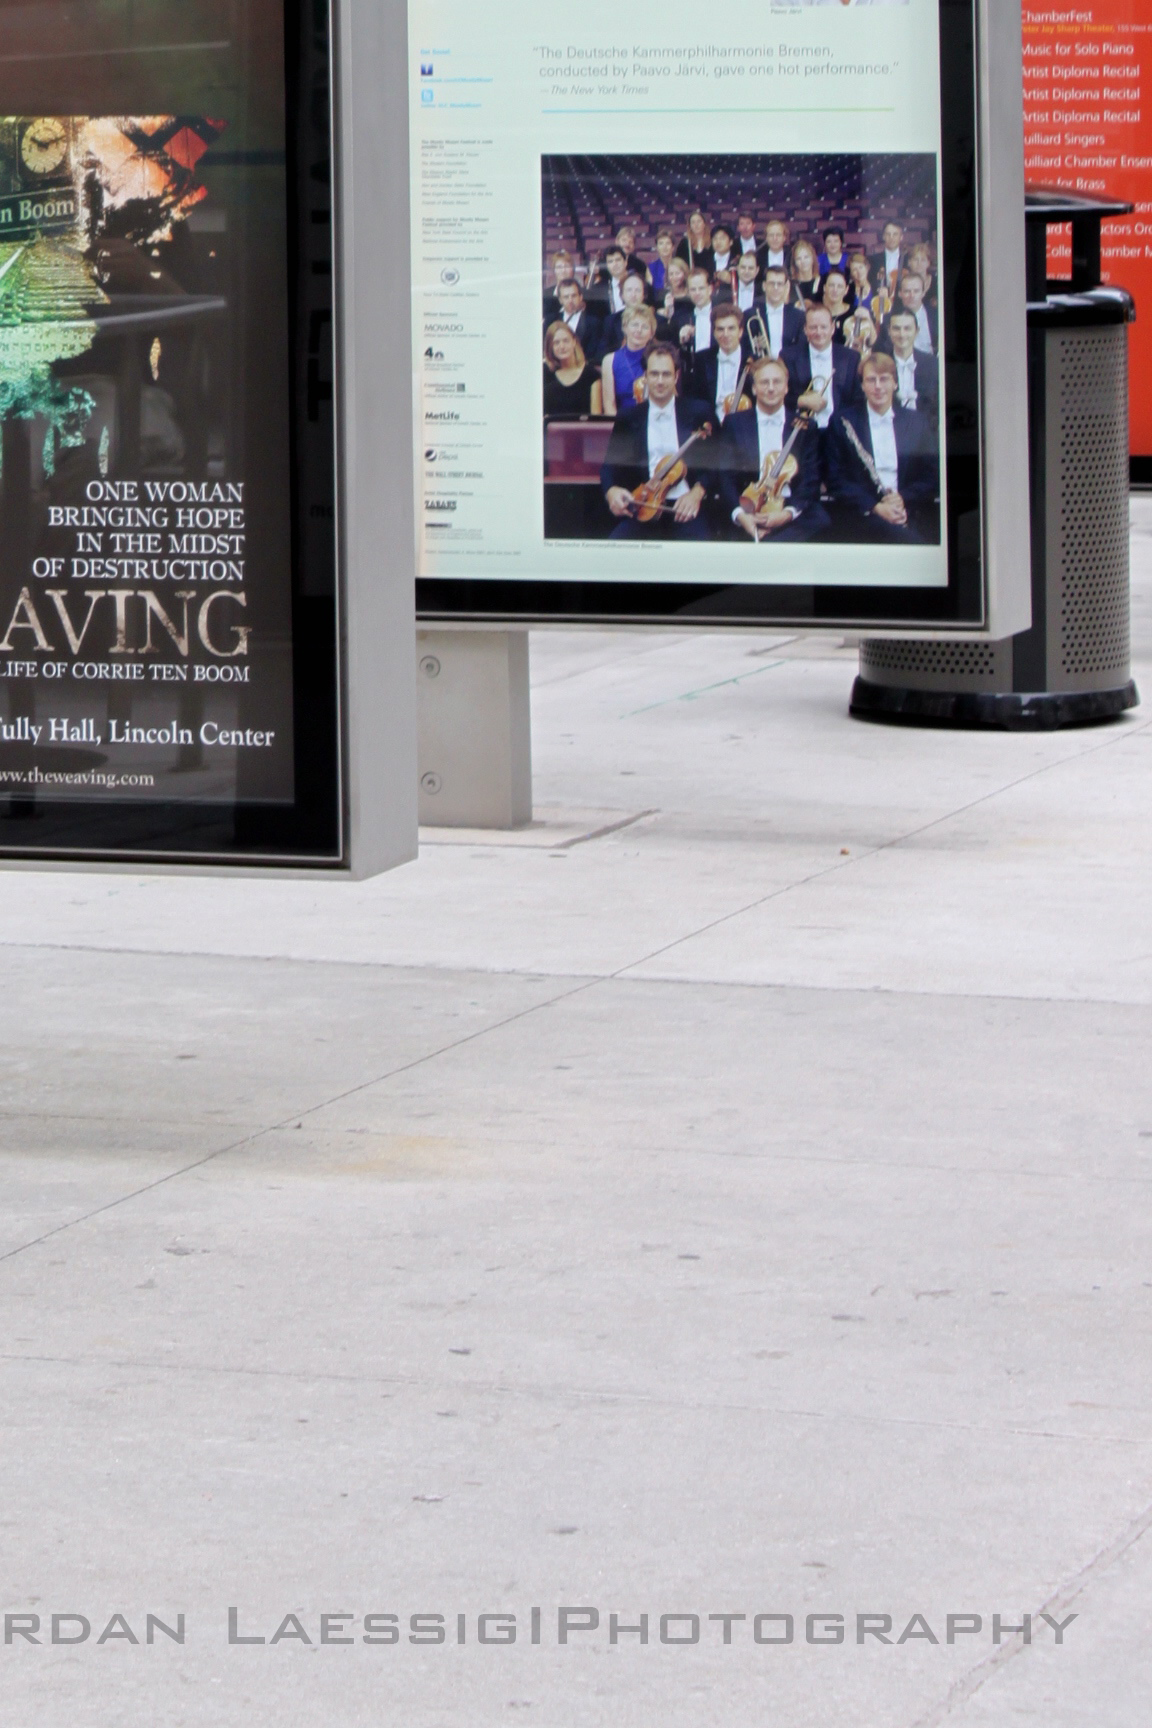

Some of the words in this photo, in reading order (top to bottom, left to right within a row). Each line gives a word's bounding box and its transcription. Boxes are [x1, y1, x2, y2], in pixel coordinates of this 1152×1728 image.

[1055, 42, 1071, 55] for
[1075, 43, 1099, 55] Solo
[1103, 44, 1134, 55] Piano
[1052, 65, 1099, 80] Diploma
[1103, 64, 1140, 78] Recital
[1064, 133, 1105, 148] Singers
[1065, 155, 1117, 167] Chamber
[1076, 178, 1105, 190] Brass
[17, 196, 75, 222] Boom
[424, 324, 463, 332] MOVADO
[85, 481, 138, 503] ONE
[144, 481, 243, 504] WOMAN
[48, 507, 168, 529] BRINGING
[175, 509, 244, 530] HOPE
[76, 533, 102, 553] IN
[109, 533, 162, 554] THE
[168, 535, 245, 556] MIDST
[32, 557, 65, 578] OF
[71, 558, 244, 581] DESTRUCTION
[42, 662, 68, 679] OF
[71, 662, 144, 680] CORRIE
[148, 664, 188, 681] TEN
[193, 665, 249, 683] BOOM
[49, 719, 101, 749] Hall,
[109, 720, 192, 745] Lincoln
[199, 722, 274, 747] Center
